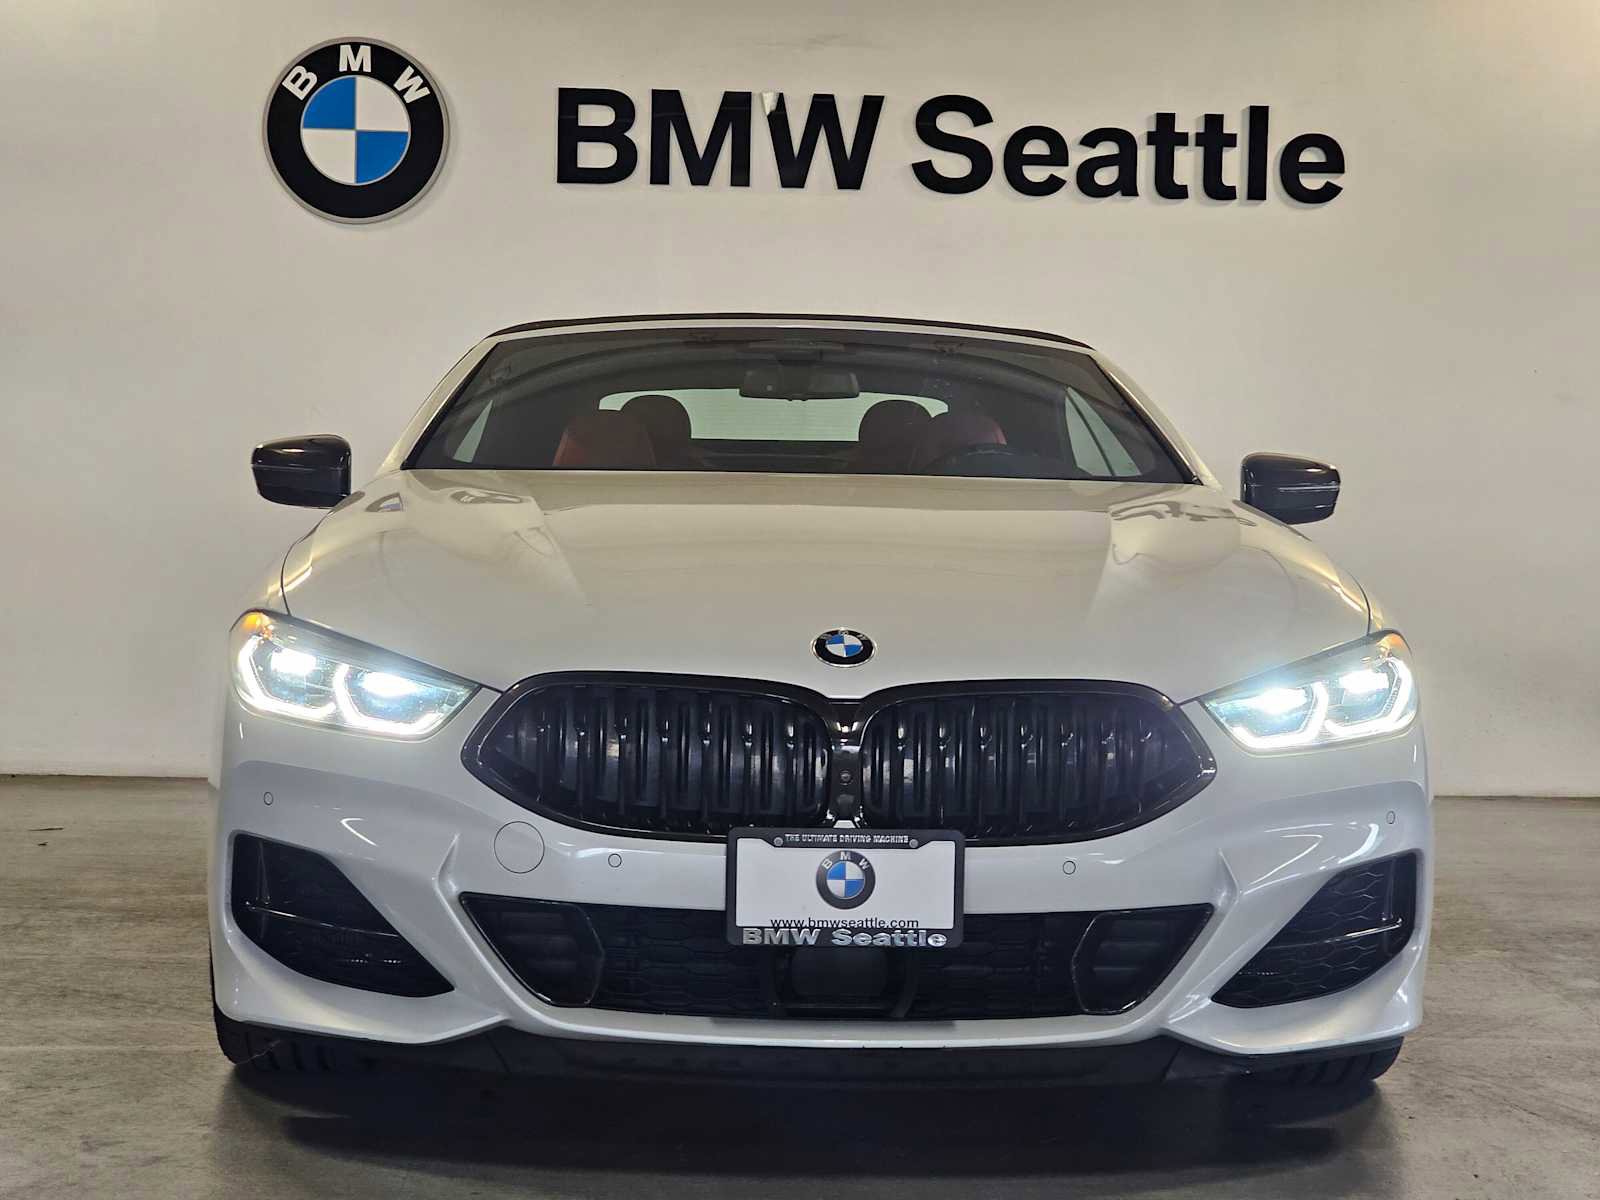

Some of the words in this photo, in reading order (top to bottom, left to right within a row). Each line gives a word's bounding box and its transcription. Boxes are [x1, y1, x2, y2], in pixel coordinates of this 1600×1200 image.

[282, 44, 431, 104] BMW
[556, 87, 885, 190] BMW
[911, 94, 1346, 203] Seattle
[784, 833, 800, 842] THE
[801, 833, 838, 843] ULTIMATE
[839, 834, 872, 843] DRIVING
[873, 835, 909, 844] MACHINE
[821, 851, 870, 870] BMW
[770, 917, 919, 928] www.bmwseattle.com
[742, 928, 821, 945] BMW
[831, 929, 947, 947] Seattle
